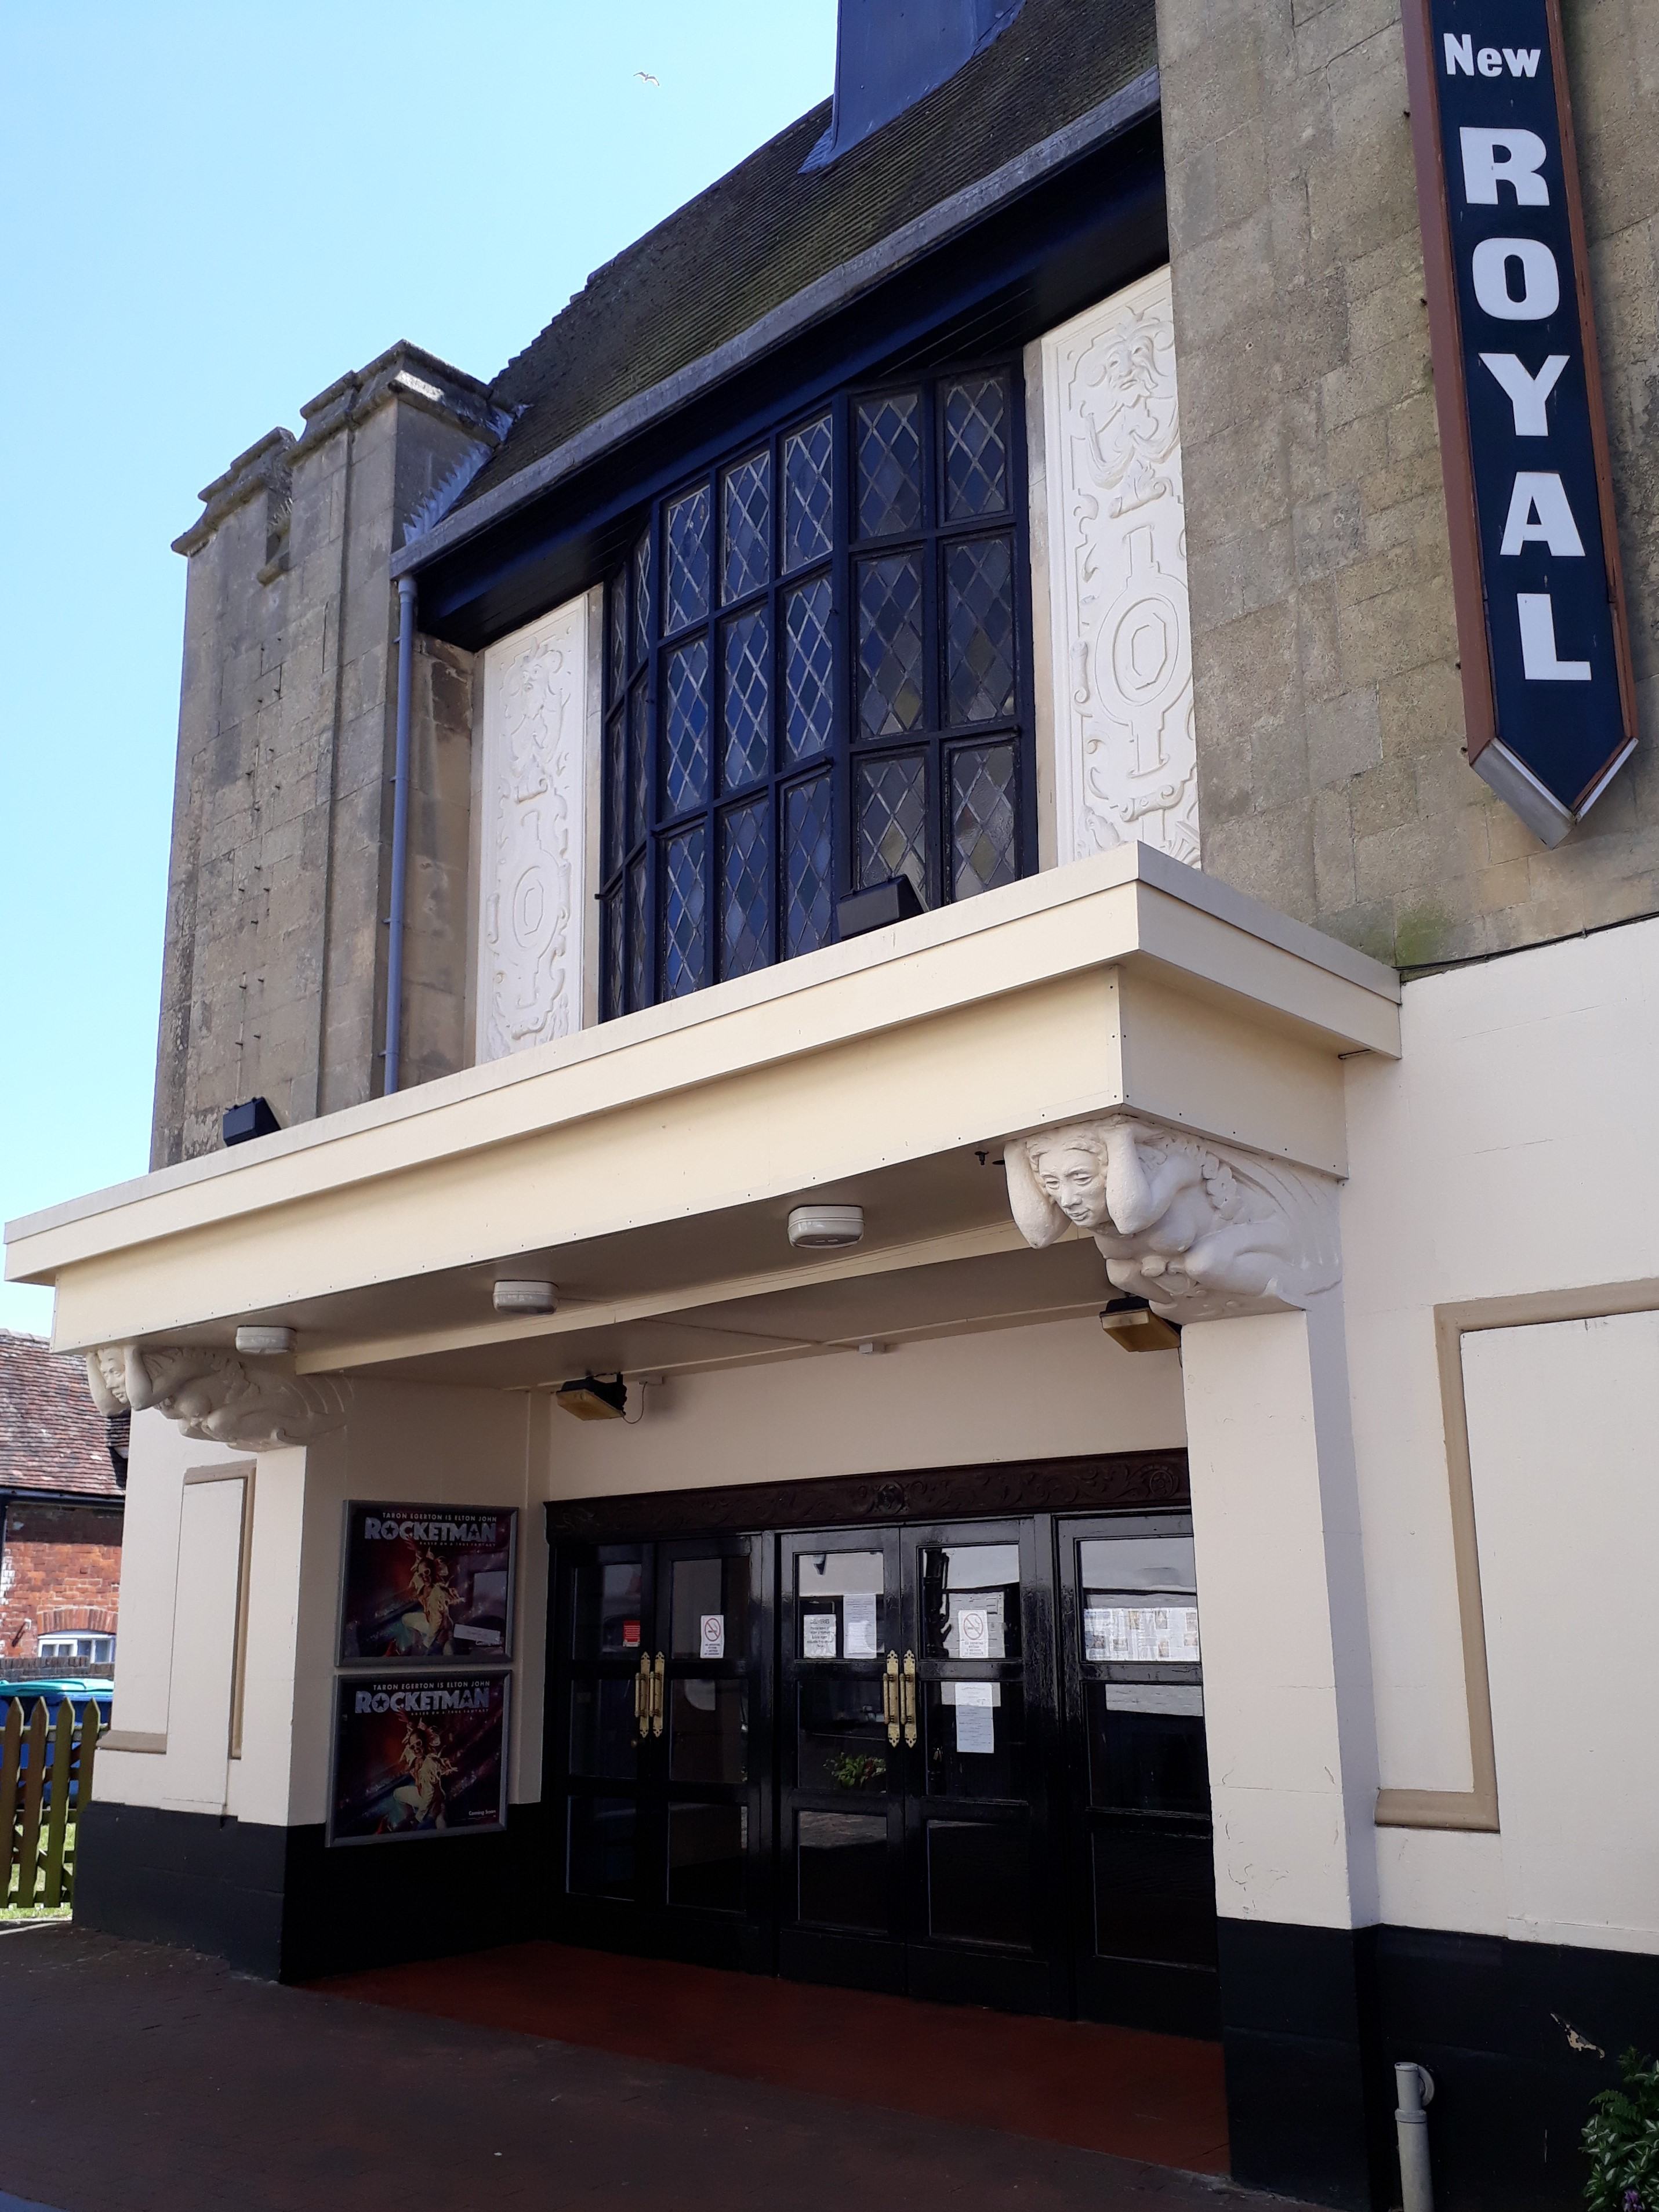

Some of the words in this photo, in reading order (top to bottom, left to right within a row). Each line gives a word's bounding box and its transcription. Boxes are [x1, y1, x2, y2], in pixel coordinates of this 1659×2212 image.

[1443, 33, 1541, 77] New
[1460, 126, 1592, 680] ROYAL
[365, 1517, 496, 1542] ROCKETMAN
[355, 1687, 489, 1713] ROCKETMAN
